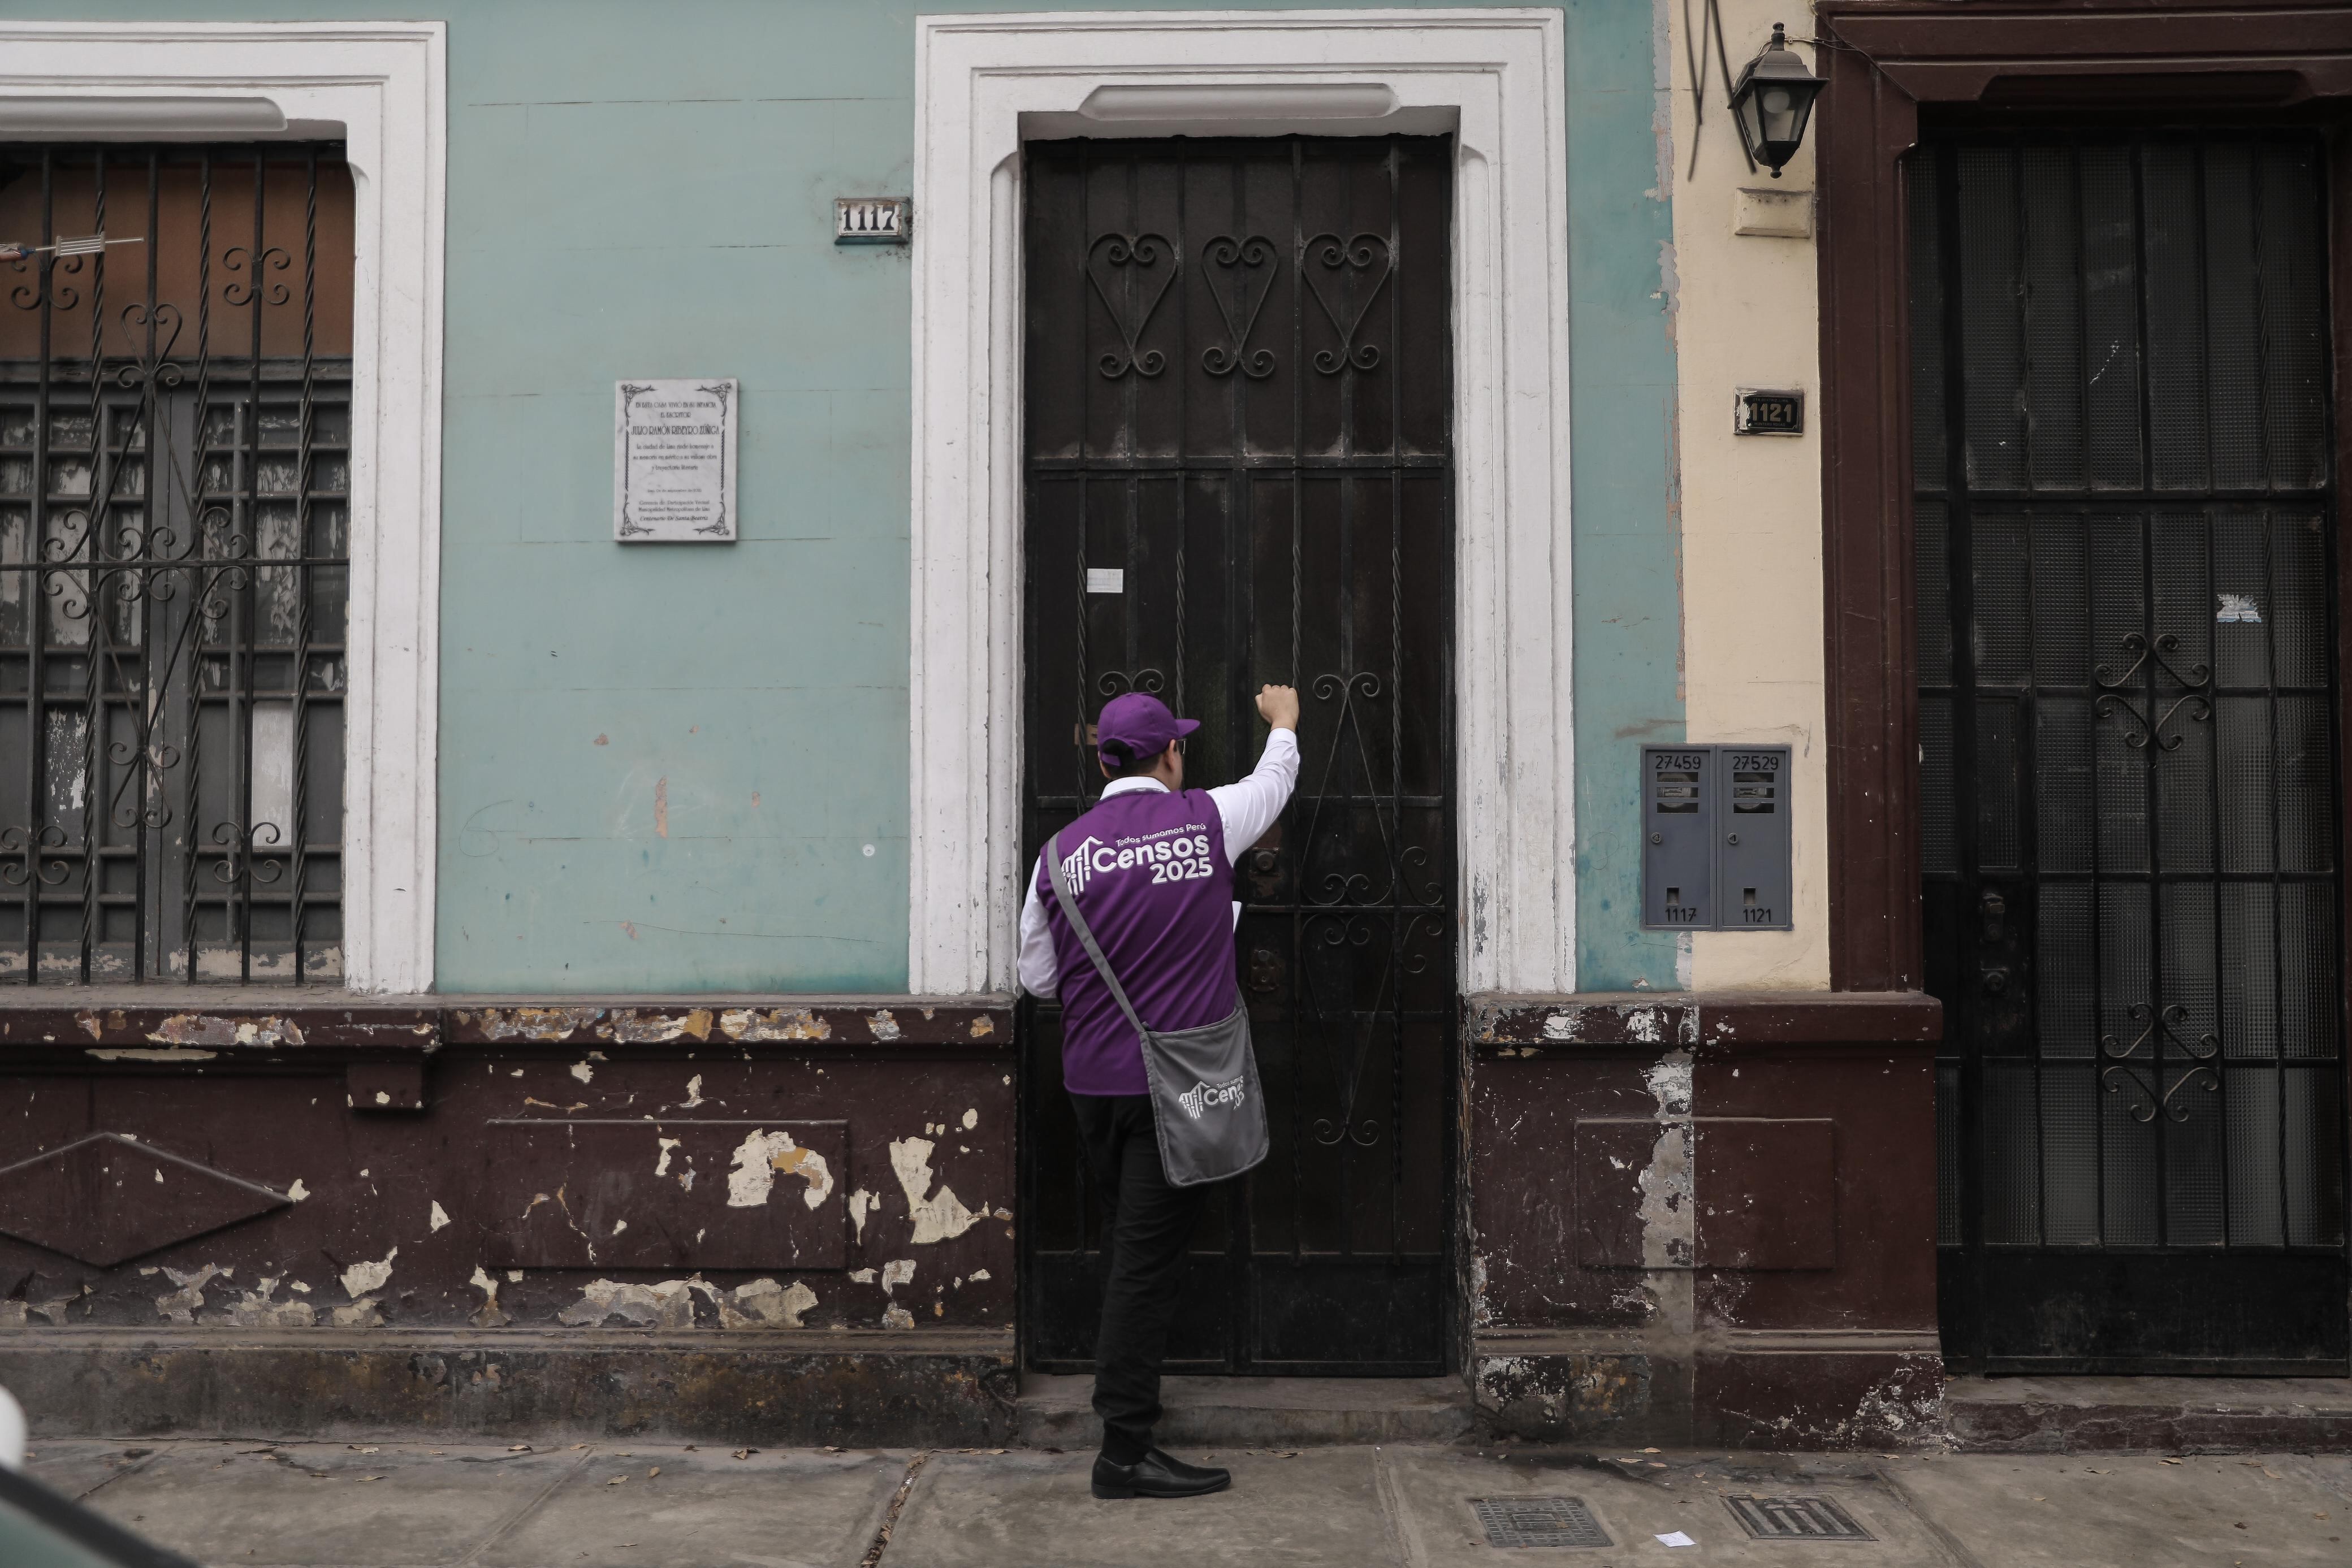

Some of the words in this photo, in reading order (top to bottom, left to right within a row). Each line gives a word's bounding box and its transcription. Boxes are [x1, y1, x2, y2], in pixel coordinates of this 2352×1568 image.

[843, 204, 896, 231] 1117
[1750, 402, 1792, 423] 1121
[632, 426, 647, 435] JULIO
[649, 424, 670, 435] RAMÓN
[672, 426, 698, 435] RIBEYRO
[699, 424, 720, 435] ZÚÑIGA
[1655, 755, 1701, 769] 27459
[1733, 756, 1779, 770] 27529
[1116, 836, 1141, 847] Todos
[1142, 826, 1184, 841] sumamos
[1092, 834, 1209, 873] Censos
[1149, 856, 1213, 883] 2025
[1665, 908, 1697, 922] 1117
[1743, 908, 1771, 922] 1121
